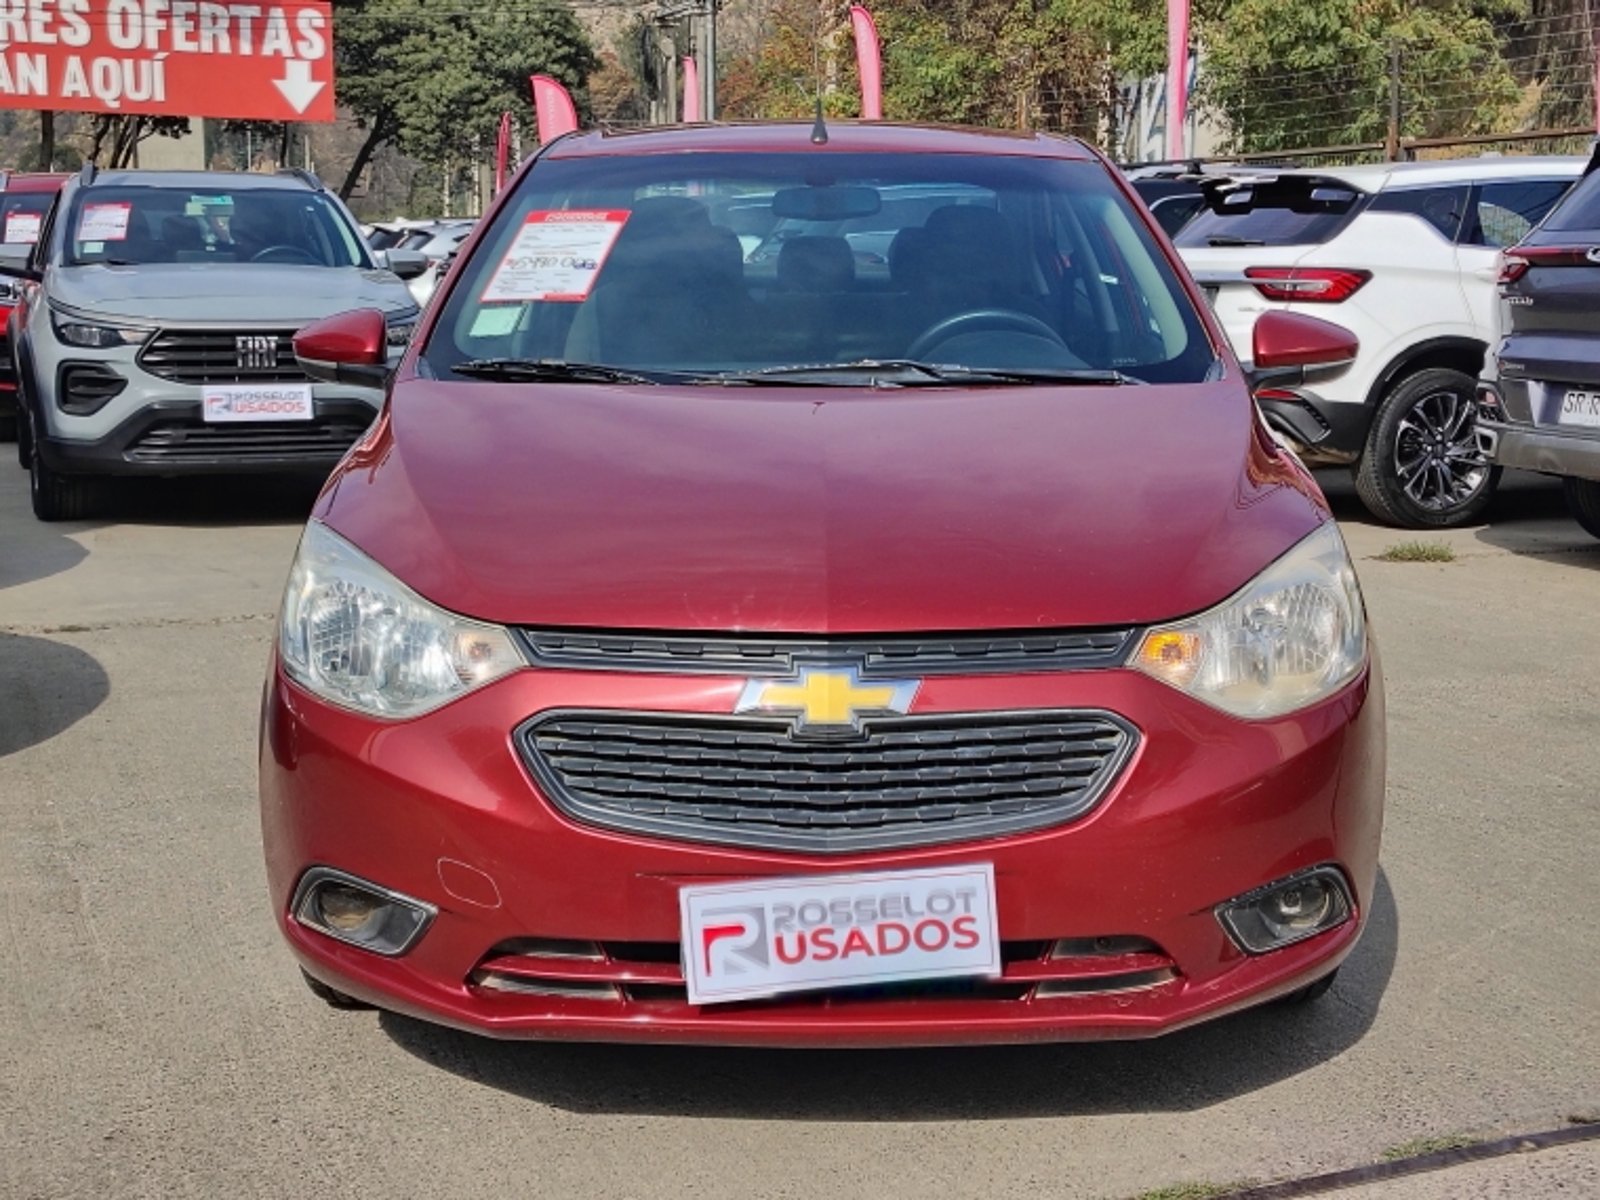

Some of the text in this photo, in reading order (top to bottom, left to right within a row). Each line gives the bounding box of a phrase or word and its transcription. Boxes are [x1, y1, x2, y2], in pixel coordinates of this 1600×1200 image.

[0, 0, 326, 60] RES OFERTAS
[61, 52, 170, 108] AQUÍ
[236, 336, 278, 367] FIAT
[233, 401, 306, 414] USADOS
[772, 886, 978, 932] ROSSELOT
[775, 916, 981, 965] USADOS
